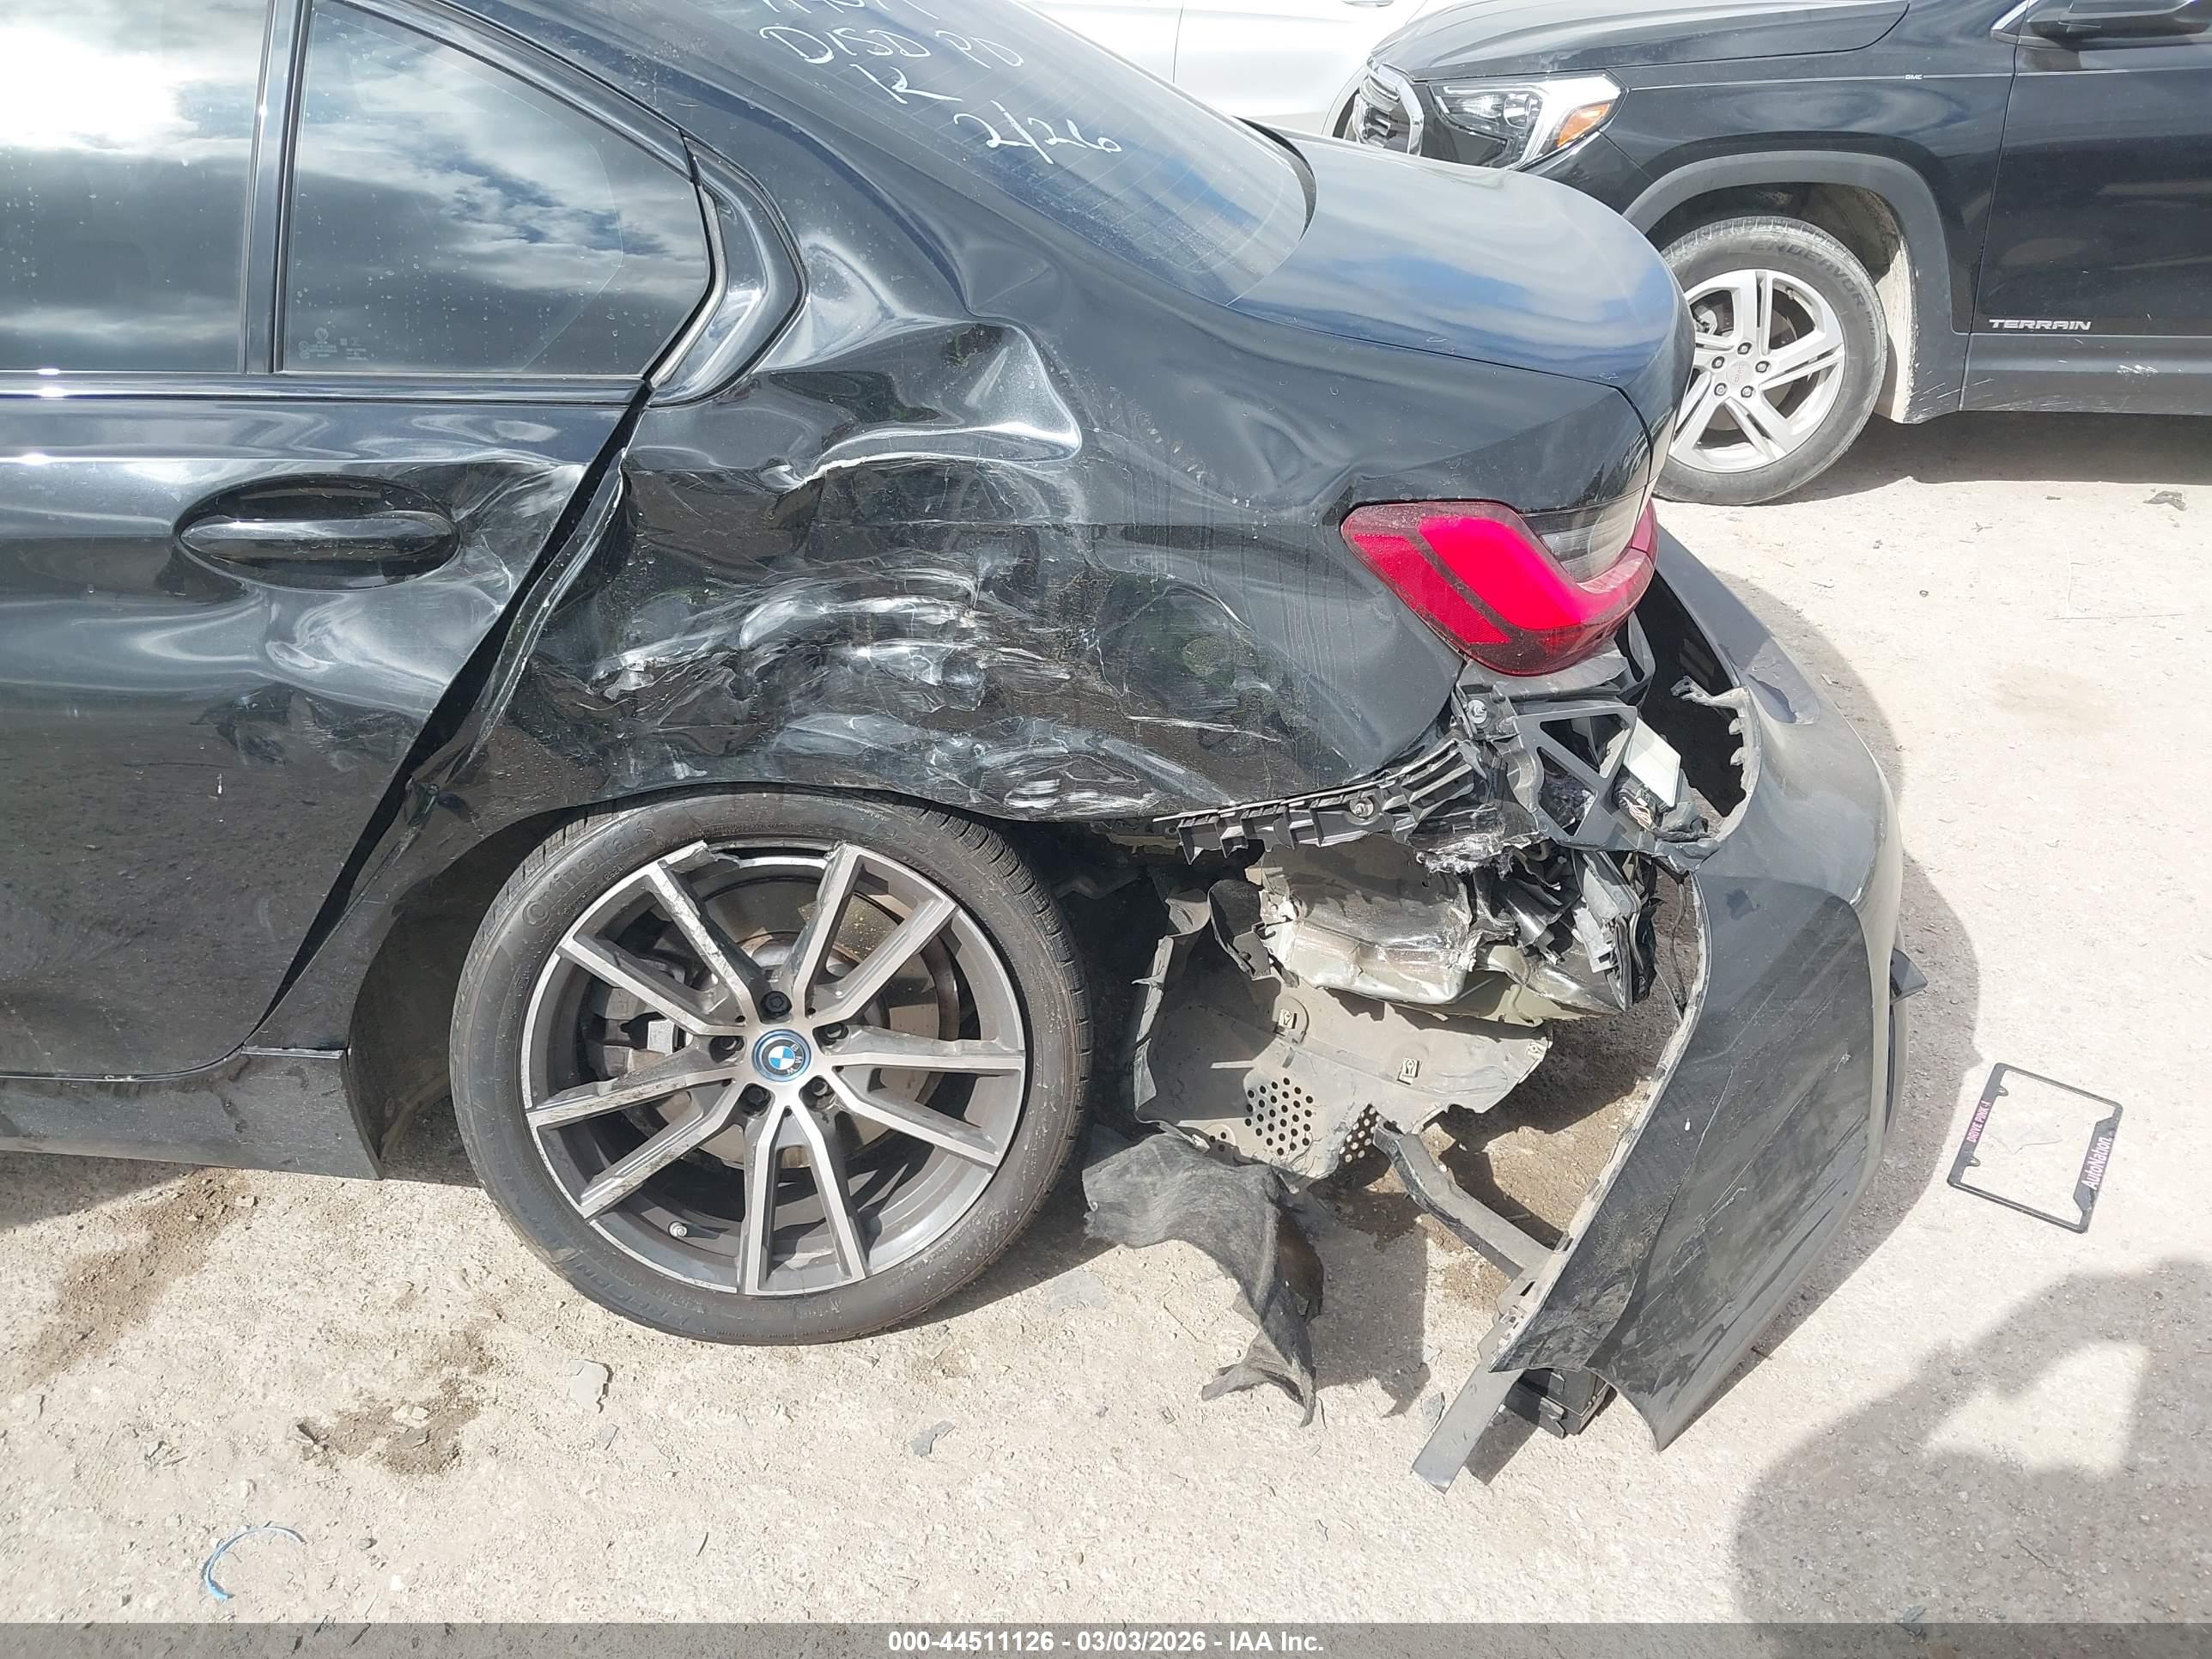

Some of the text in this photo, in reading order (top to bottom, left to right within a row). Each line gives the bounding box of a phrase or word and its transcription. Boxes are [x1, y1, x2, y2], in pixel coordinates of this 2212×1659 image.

[953, 99, 1123, 165] 2/26
[1988, 319, 2093, 331] TERRAIN
[787, 1042, 804, 1075] BMW
[1966, 1106, 1990, 1143] DRIVE PINK
